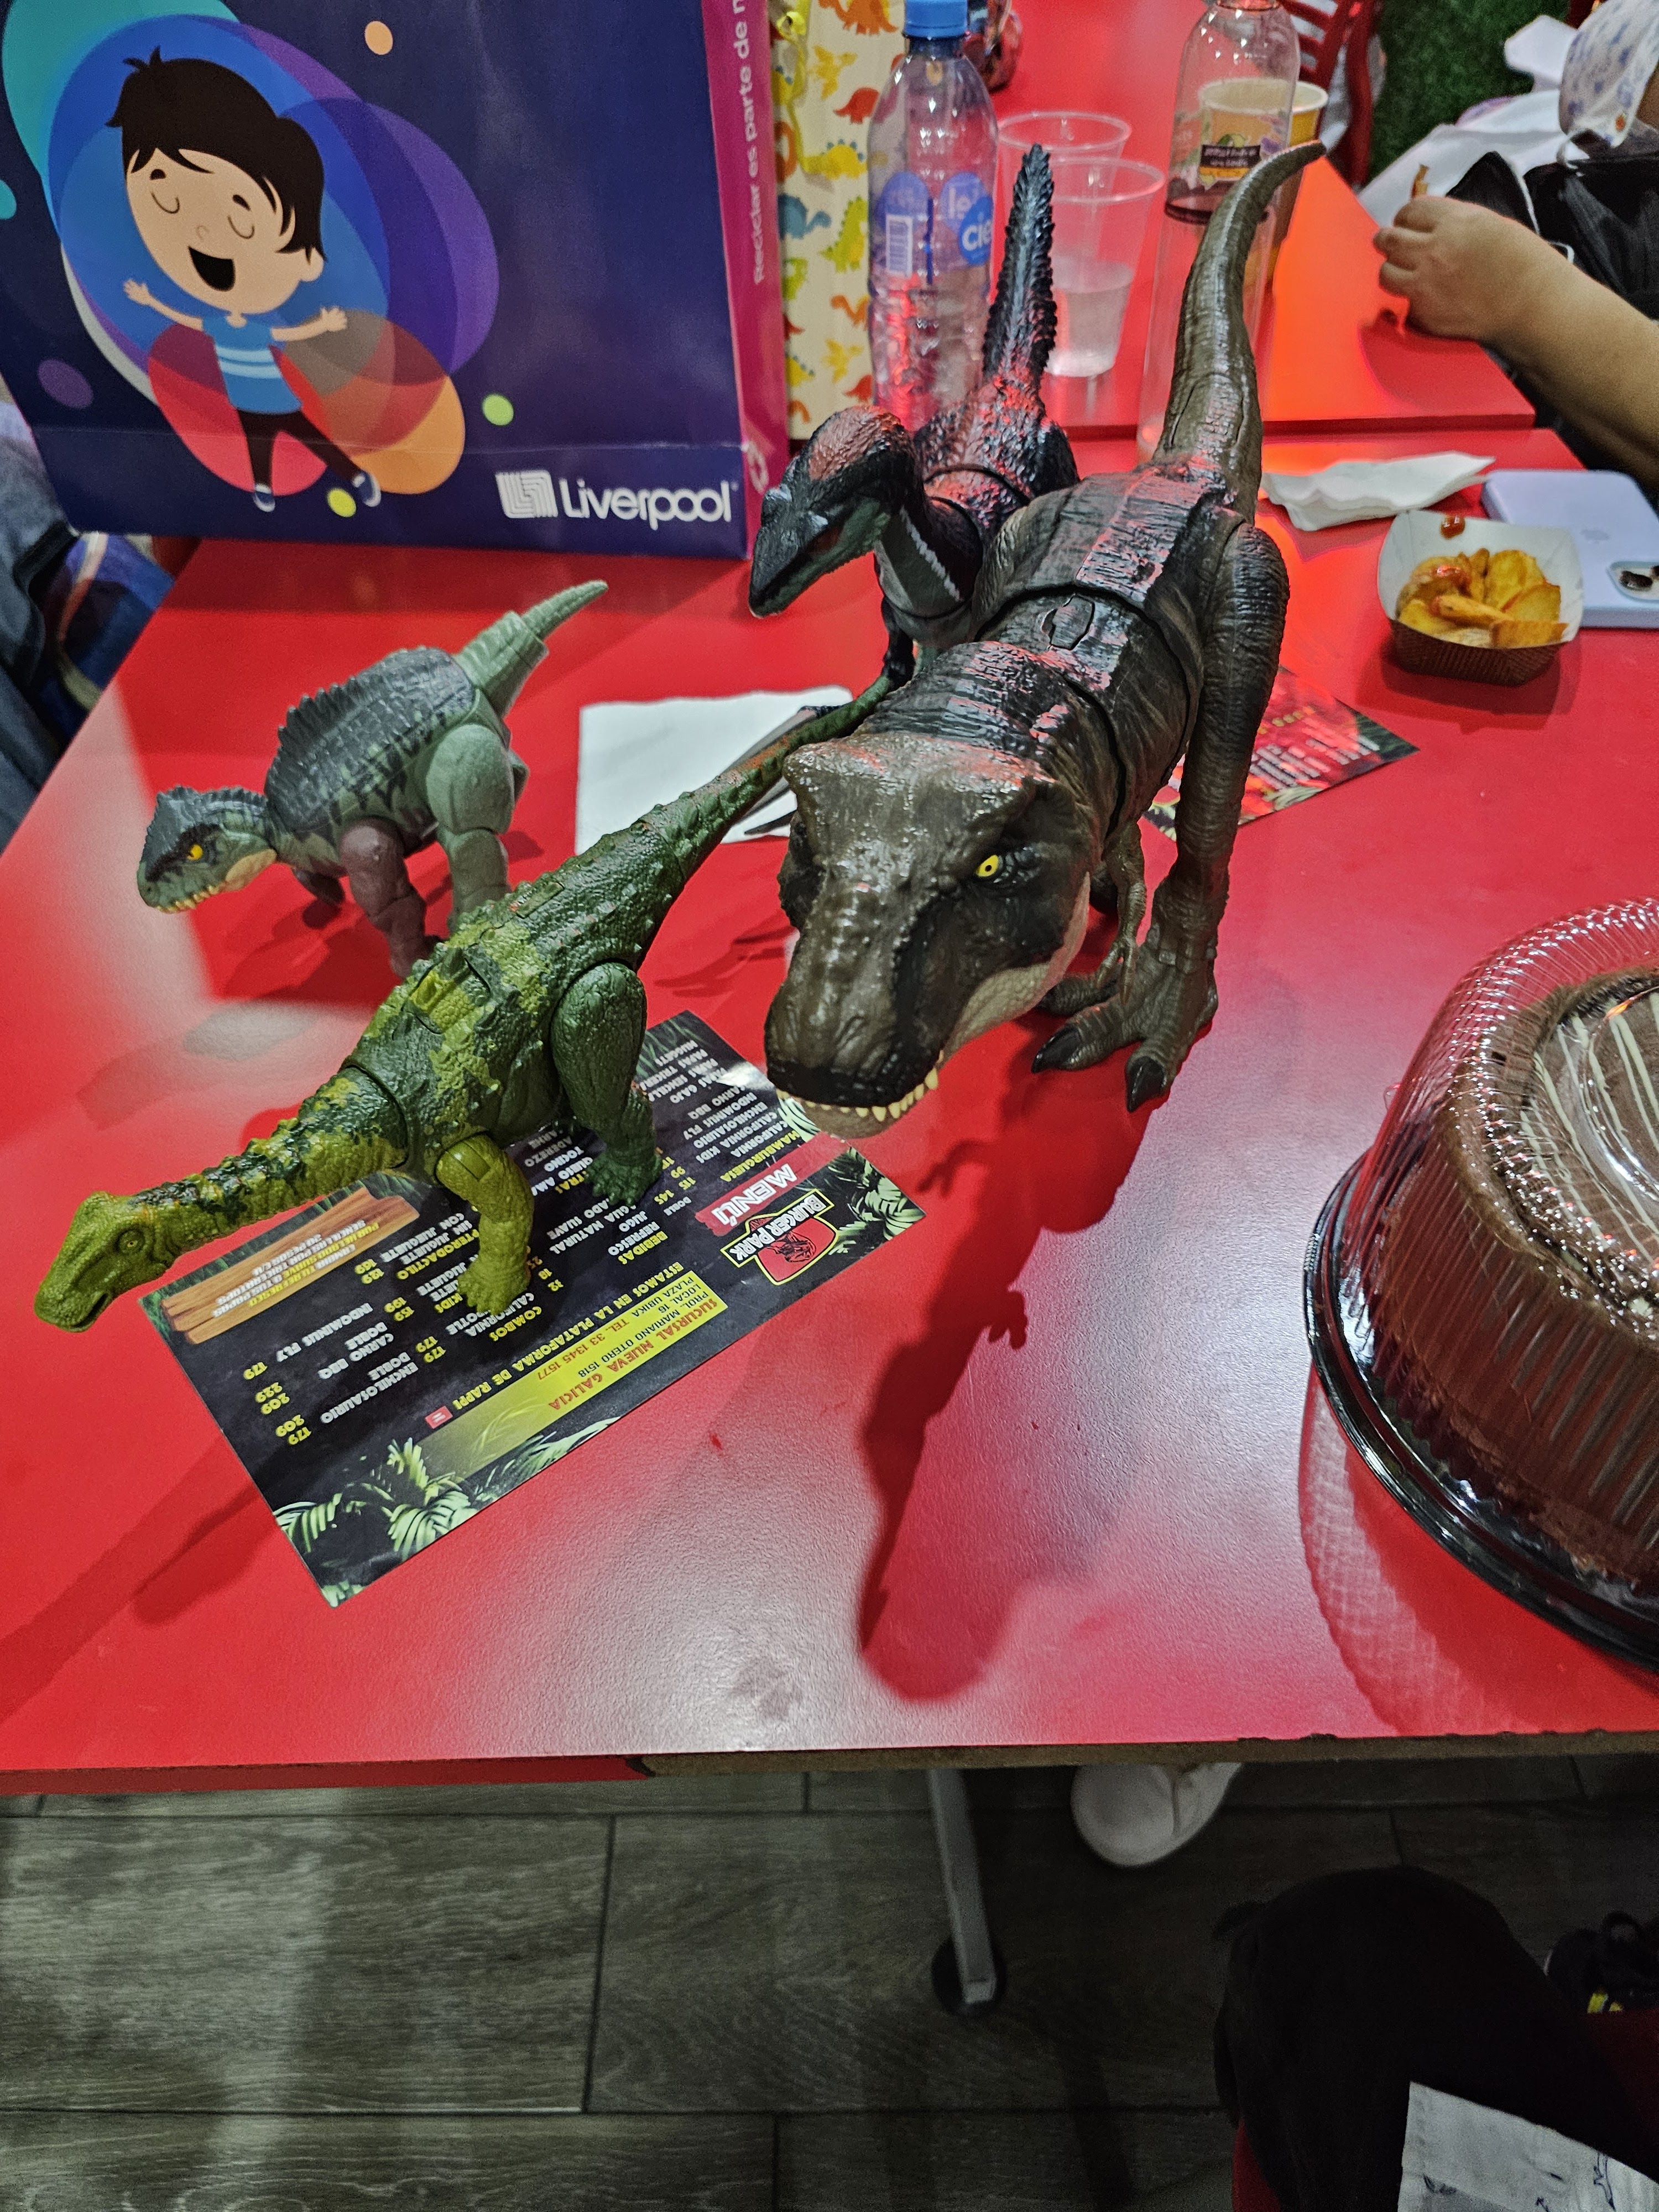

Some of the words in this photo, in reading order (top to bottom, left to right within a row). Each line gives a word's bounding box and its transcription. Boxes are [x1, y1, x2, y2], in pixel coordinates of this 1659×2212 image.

[733, 21, 749, 59] de
[739, 65, 758, 142] parte
[748, 145, 758, 178] es
[750, 185, 764, 285] Reciclar
[559, 478, 731, 530] Liverpool
[652, 1039, 700, 1067] NUGGETS
[675, 1047, 709, 1070] PAPAS
[686, 1057, 719, 1078] PAPAS
[643, 1073, 691, 1103] SENCILLA
[666, 1083, 700, 1104] GAJO
[686, 1103, 712, 1120] BBQ
[702, 1092, 757, 1128] INDOMINUS
[683, 1124, 702, 1140] FLY
[693, 1102, 768, 1148] ENCHILOSAURIO
[719, 1112, 777, 1147] CALIFORNIA
[730, 1120, 791, 1157] CALIFORNIA
[521, 1135, 576, 1168] ADEREZO
[544, 1146, 583, 1171] TOCINO
[695, 1145, 720, 1163] KIDS
[719, 1130, 804, 1182] HAMBURGUESA
[557, 1157, 593, 1179] QUESO
[670, 1166, 685, 1178] 99
[552, 1169, 591, 1195] TRAS
[678, 1176, 696, 1190] 115
[654, 1190, 674, 1204] 145
[663, 1196, 691, 1215] DOBLE
[711, 1163, 797, 1227] MENÚ
[581, 1197, 614, 1220] ADO
[765, 1194, 826, 1236] BURGER
[439, 1213, 464, 1229] CON
[452, 1220, 472, 1235] SIN
[545, 1215, 583, 1241] SUAVE
[619, 1211, 648, 1232] JUGO
[399, 1232, 450, 1264] JUGUETE
[547, 1219, 605, 1256] NATURAL
[608, 1221, 660, 1255] REFRESCO
[618, 1230, 667, 1264] BEBIDAS
[725, 1227, 775, 1260] PARK
[397, 1229, 482, 1279] PTERODACTILO
[354, 1259, 377, 1274] 169
[361, 1268, 384, 1284] 129
[538, 1268, 552, 1279] 18
[416, 1262, 467, 1296] JUGUETE
[427, 1278, 463, 1303] UETE
[547, 1279, 564, 1291] 32
[632, 1261, 684, 1297] ESTAMOS
[661, 1276, 694, 1298] PLAZA
[384, 1297, 406, 1312] 199
[434, 1292, 463, 1313] KIDS
[613, 1293, 632, 1309] EN
[669, 1283, 702, 1306] LOCAL
[678, 1290, 709, 1312] PROL.
[390, 1305, 416, 1323] 159
[462, 1290, 537, 1339] CALIFORNIA
[593, 1305, 613, 1319] LA
[630, 1295, 663, 1318] UBIKA
[656, 1302, 671, 1314] 16
[301, 1302, 373, 1346] INDOMINUS
[489, 1306, 541, 1341] COMBOS
[604, 1317, 630, 1335] TEL.
[633, 1308, 681, 1342] MARIANO
[654, 1297, 719, 1342] SUCURSAL
[345, 1322, 387, 1349] DOBLE
[349, 1333, 393, 1361] CARNO
[411, 1334, 439, 1355] 179
[512, 1317, 594, 1371] PLATAFORMA
[588, 1332, 606, 1346] 33
[276, 1342, 301, 1361] FLY
[420, 1344, 447, 1365] 179
[561, 1343, 589, 1363] 1345
[599, 1338, 635, 1363] OTERO
[606, 1339, 654, 1374] NUEVA
[243, 1361, 267, 1379] 179
[317, 1358, 348, 1379] BBQ
[367, 1352, 410, 1380] DOBLE
[491, 1369, 512, 1385] DE
[534, 1360, 561, 1380] 1577
[576, 1360, 601, 1378] 1518
[255, 1382, 282, 1402] 229
[260, 1392, 289, 1414] 209
[320, 1361, 418, 1423] ENCHILOSAURIO
[452, 1381, 492, 1410] RAPPI
[547, 1371, 606, 1412] GALICIA
[275, 1414, 304, 1437] 209
[288, 1427, 311, 1444] 179
